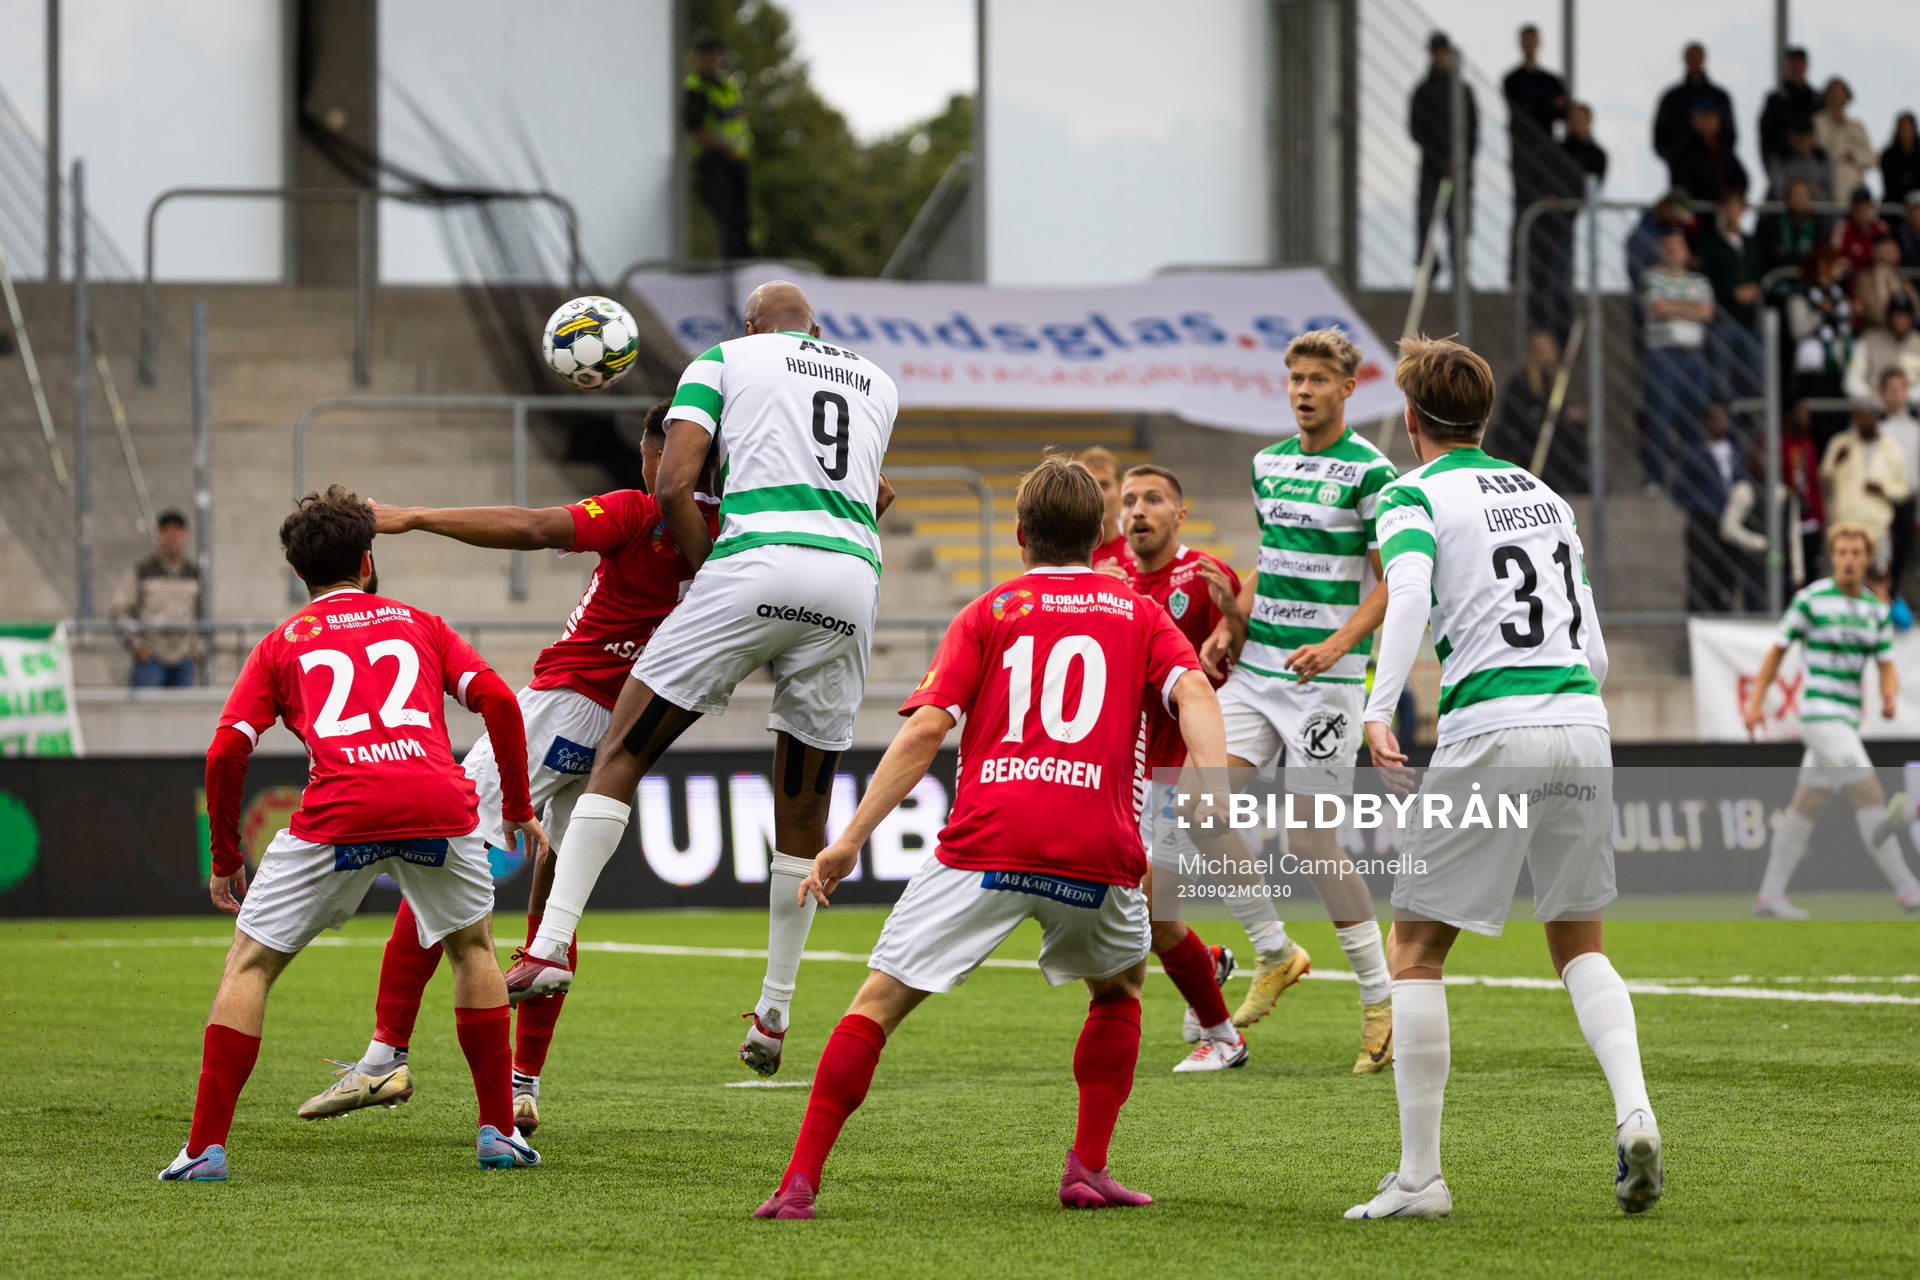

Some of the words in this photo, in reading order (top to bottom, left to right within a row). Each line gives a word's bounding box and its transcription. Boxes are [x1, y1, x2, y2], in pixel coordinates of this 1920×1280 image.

[785, 356, 872, 397] ABDIHAKIM
[812, 390, 850, 481] 9
[1475, 474, 1537, 494] ABB
[1484, 502, 1563, 533] LARSSON
[1041, 593, 1095, 605] GLOBALA
[1097, 592, 1134, 612] MÅLEN
[1492, 540, 1582, 650] 31
[326, 610, 375, 624] GLOBALA
[376, 606, 412, 618] MÅLEN
[329, 623, 341, 631] för
[343, 620, 370, 630] hållbar
[372, 615, 414, 625] utveckling
[757, 604, 857, 637] axelssons
[1042, 604, 1055, 612] för
[1057, 605, 1088, 614] hållbar
[1089, 604, 1134, 621] utveckling
[299, 638, 432, 739] 22
[1001, 635, 1107, 744] 10
[340, 738, 427, 764] TAMIMI
[980, 756, 1102, 790] BERGGREN
[1000, 873, 1020, 885] AB
[1022, 877, 1053, 893] KARL
[1055, 884, 1097, 903] HEDIN
